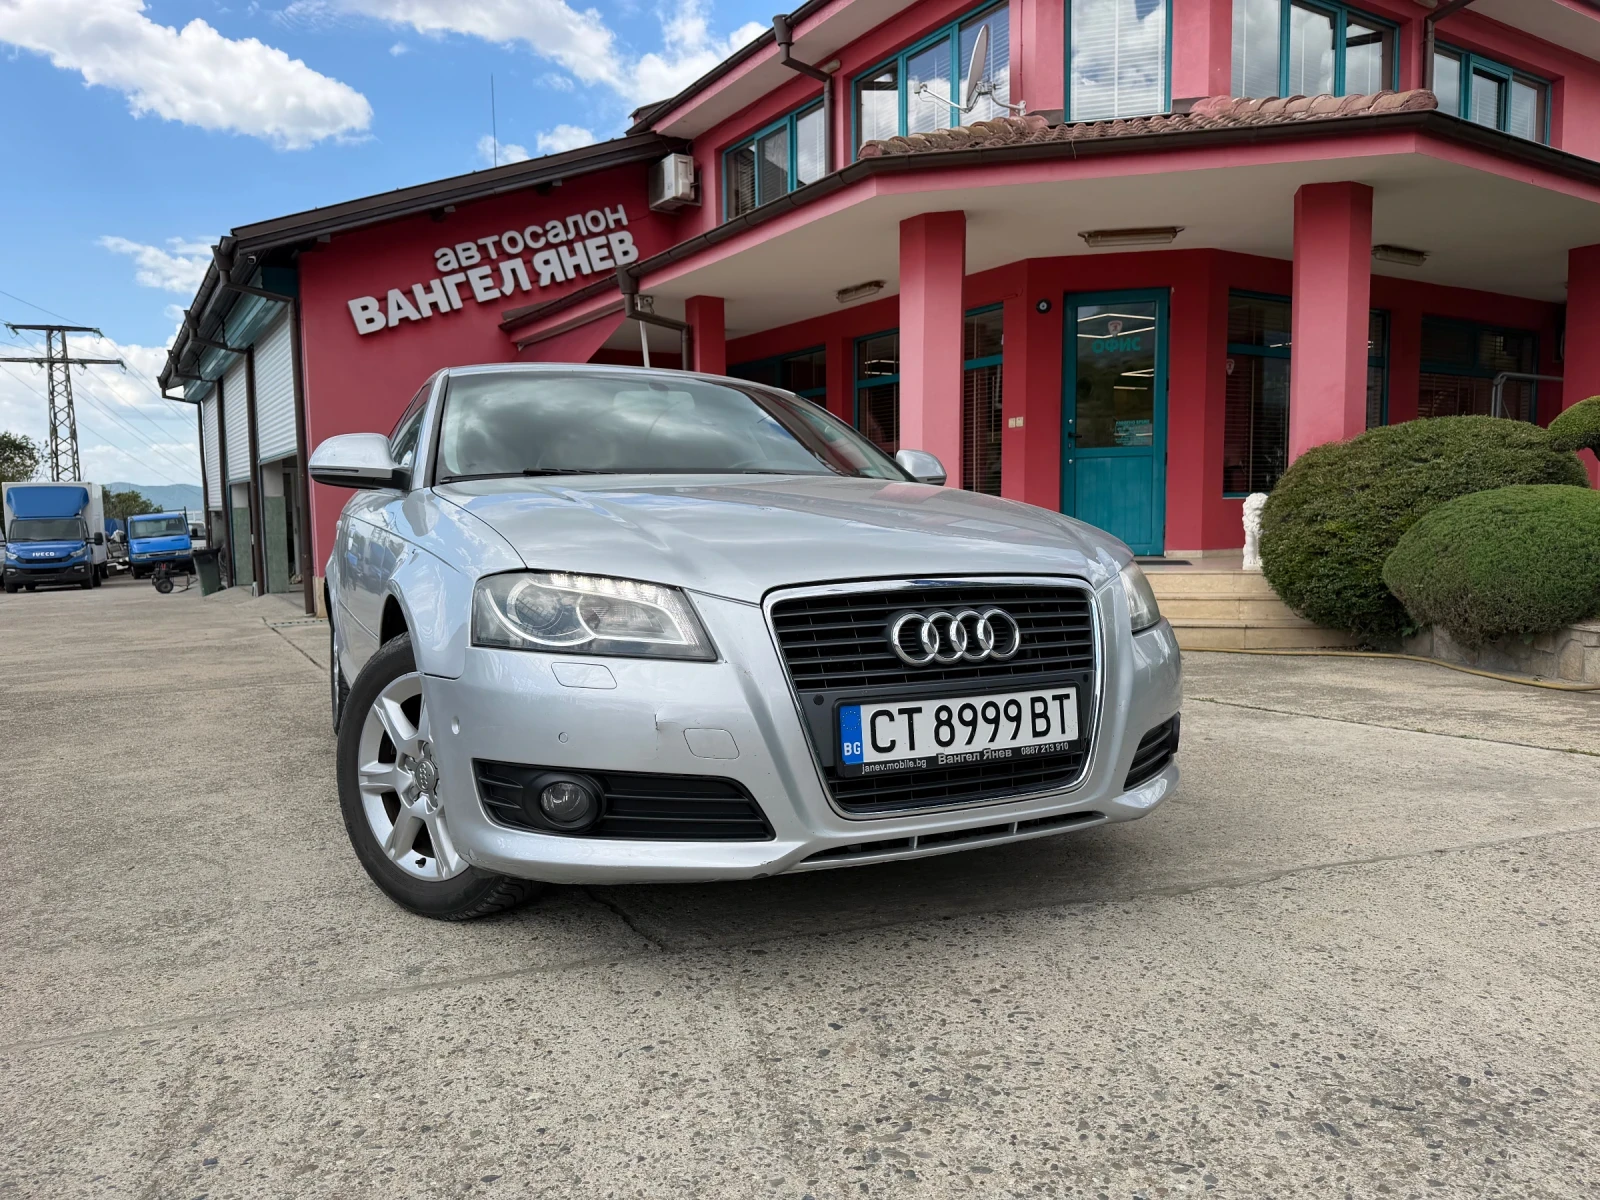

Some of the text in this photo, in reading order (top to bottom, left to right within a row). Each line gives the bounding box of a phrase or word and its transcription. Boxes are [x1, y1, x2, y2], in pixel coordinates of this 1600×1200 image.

[434, 204, 628, 272] автосалон
[347, 230, 639, 335] ВАНГЕЛ ЯНЕВ
[843, 742, 861, 756] BG
[937, 748, 1012, 765] Вангел Янев
[1020, 742, 1069, 756] 0887 213 910
[861, 759, 926, 774] janev.mobile.bg
